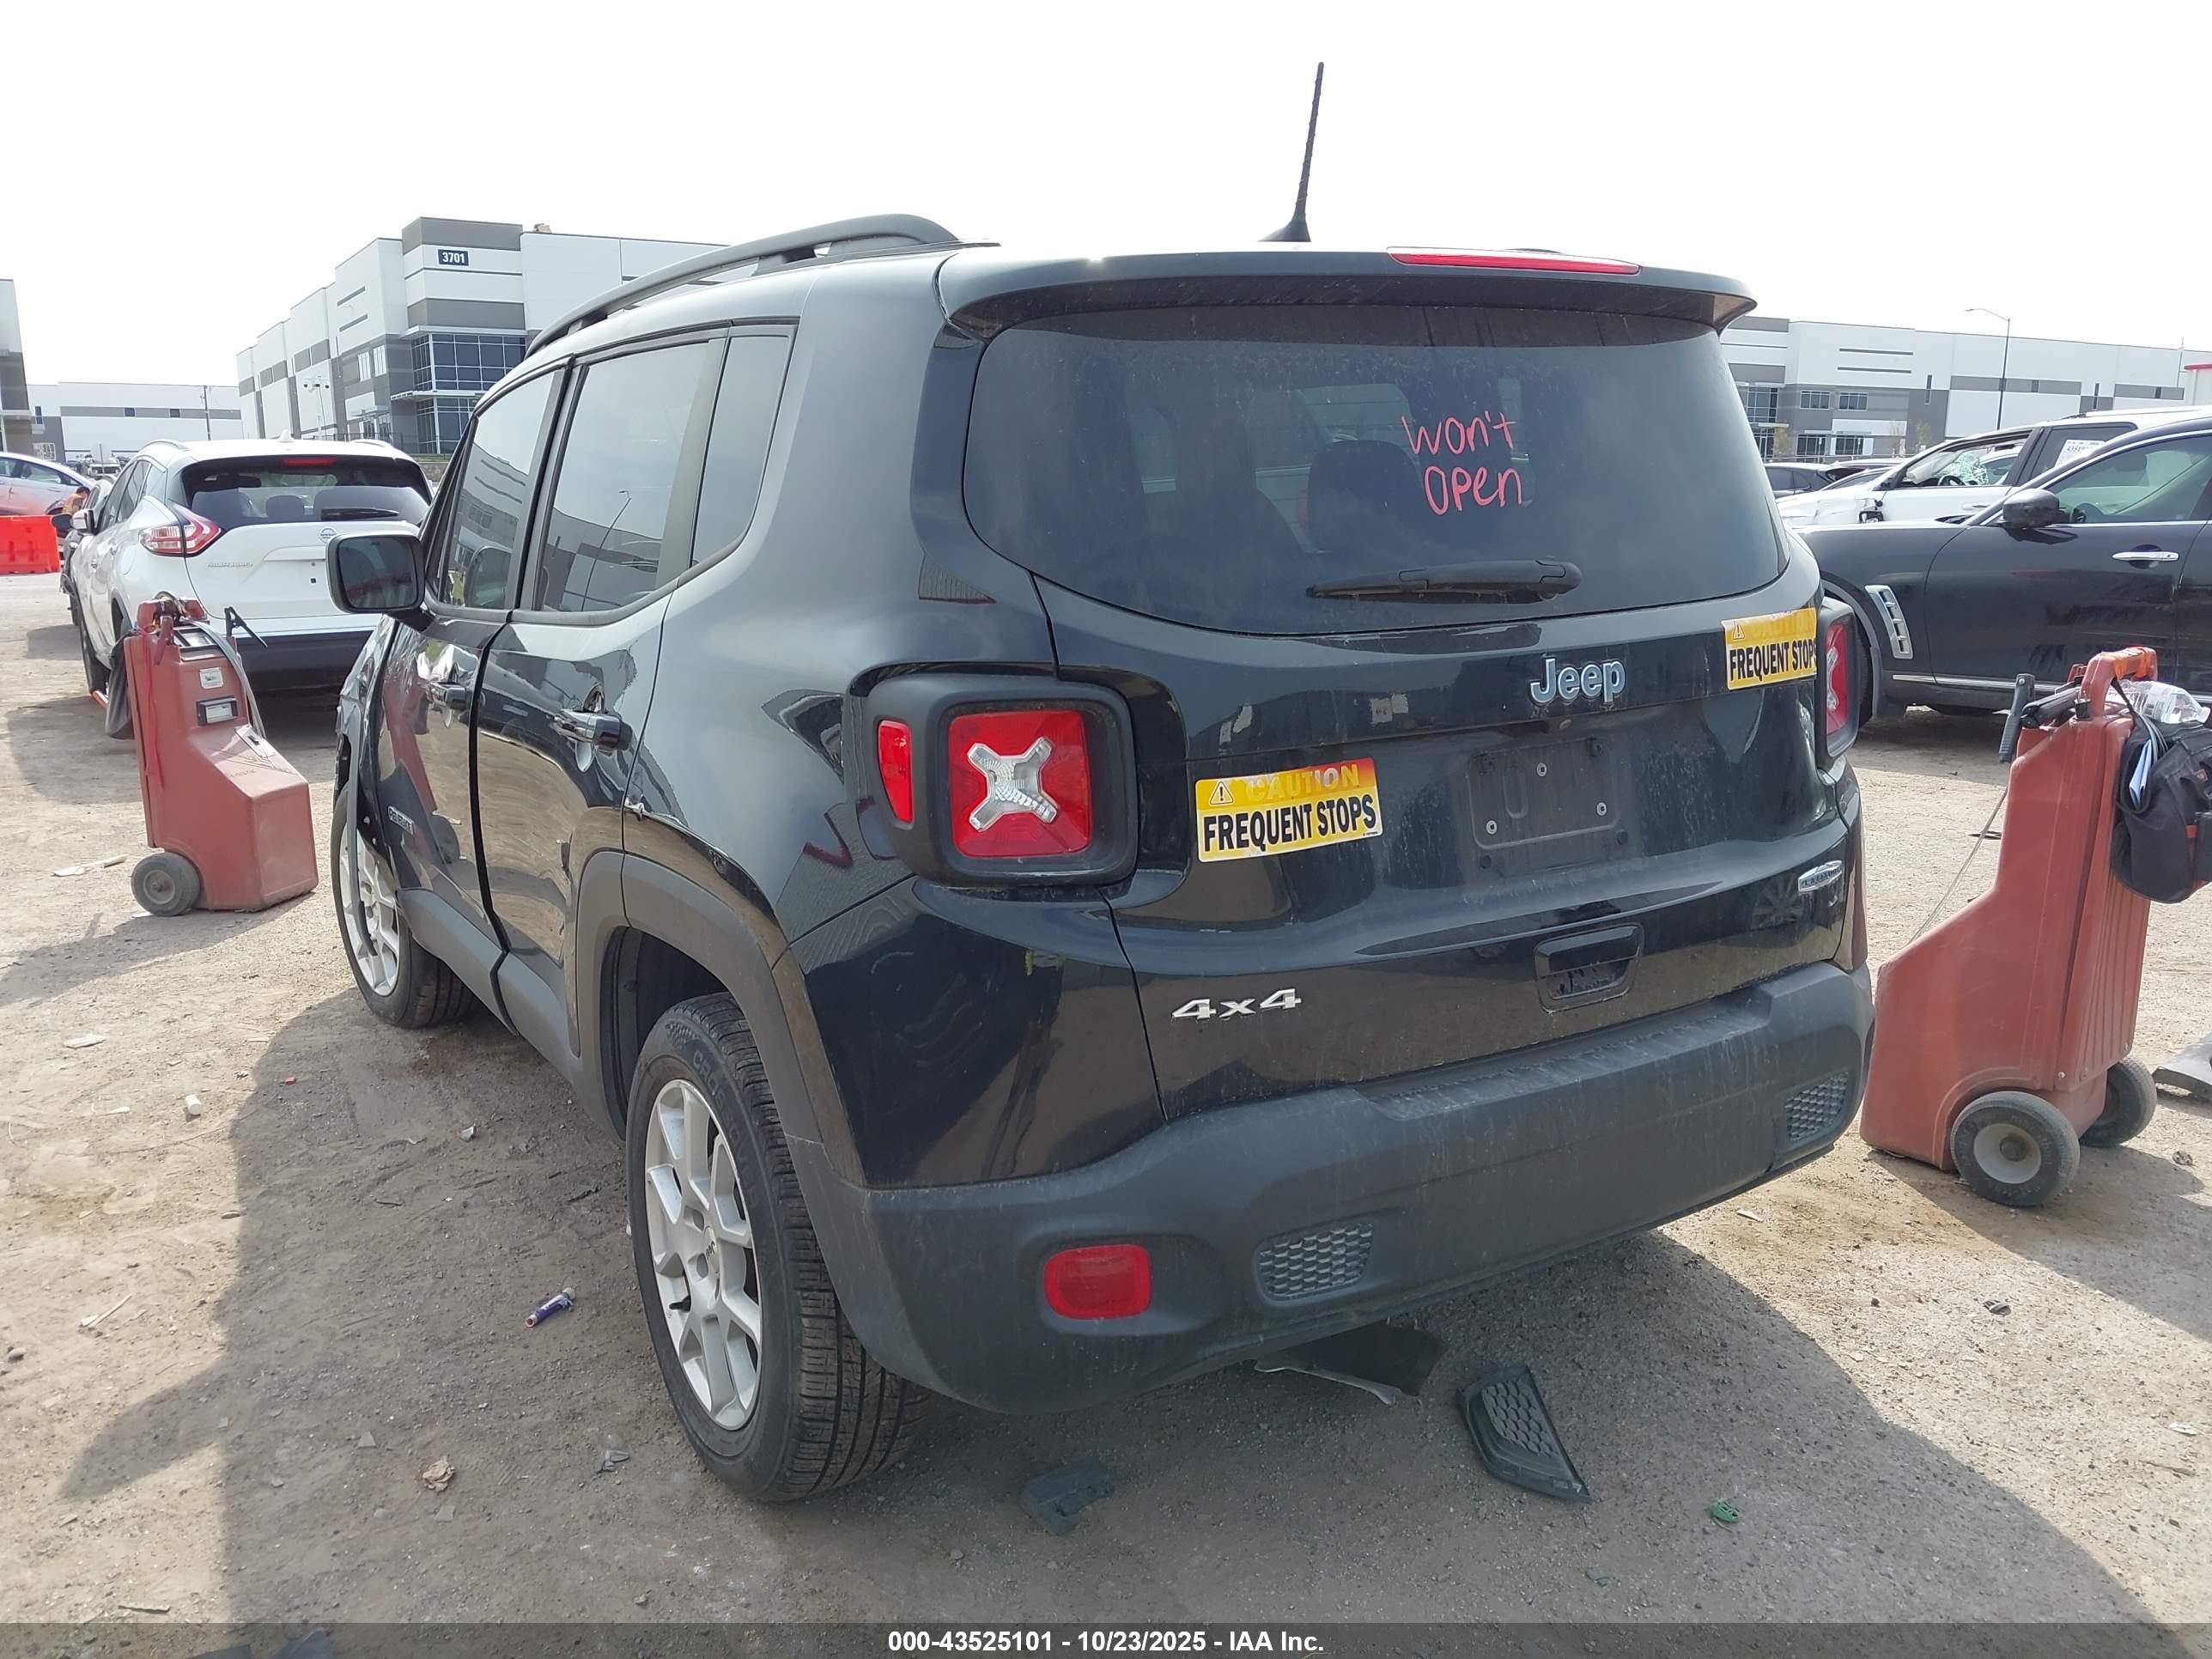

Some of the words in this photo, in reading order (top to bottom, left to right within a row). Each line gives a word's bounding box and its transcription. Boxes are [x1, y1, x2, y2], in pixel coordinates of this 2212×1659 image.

[442, 252, 465, 264] 3701
[1530, 657, 1626, 703] Jeep
[1729, 641, 1790, 681] FREQUENT
[1245, 763, 1359, 801] CAUTION
[1203, 803, 1312, 852] FREQUENT
[1316, 793, 1376, 836] STOPS
[1171, 988, 1302, 1020] 4x4
